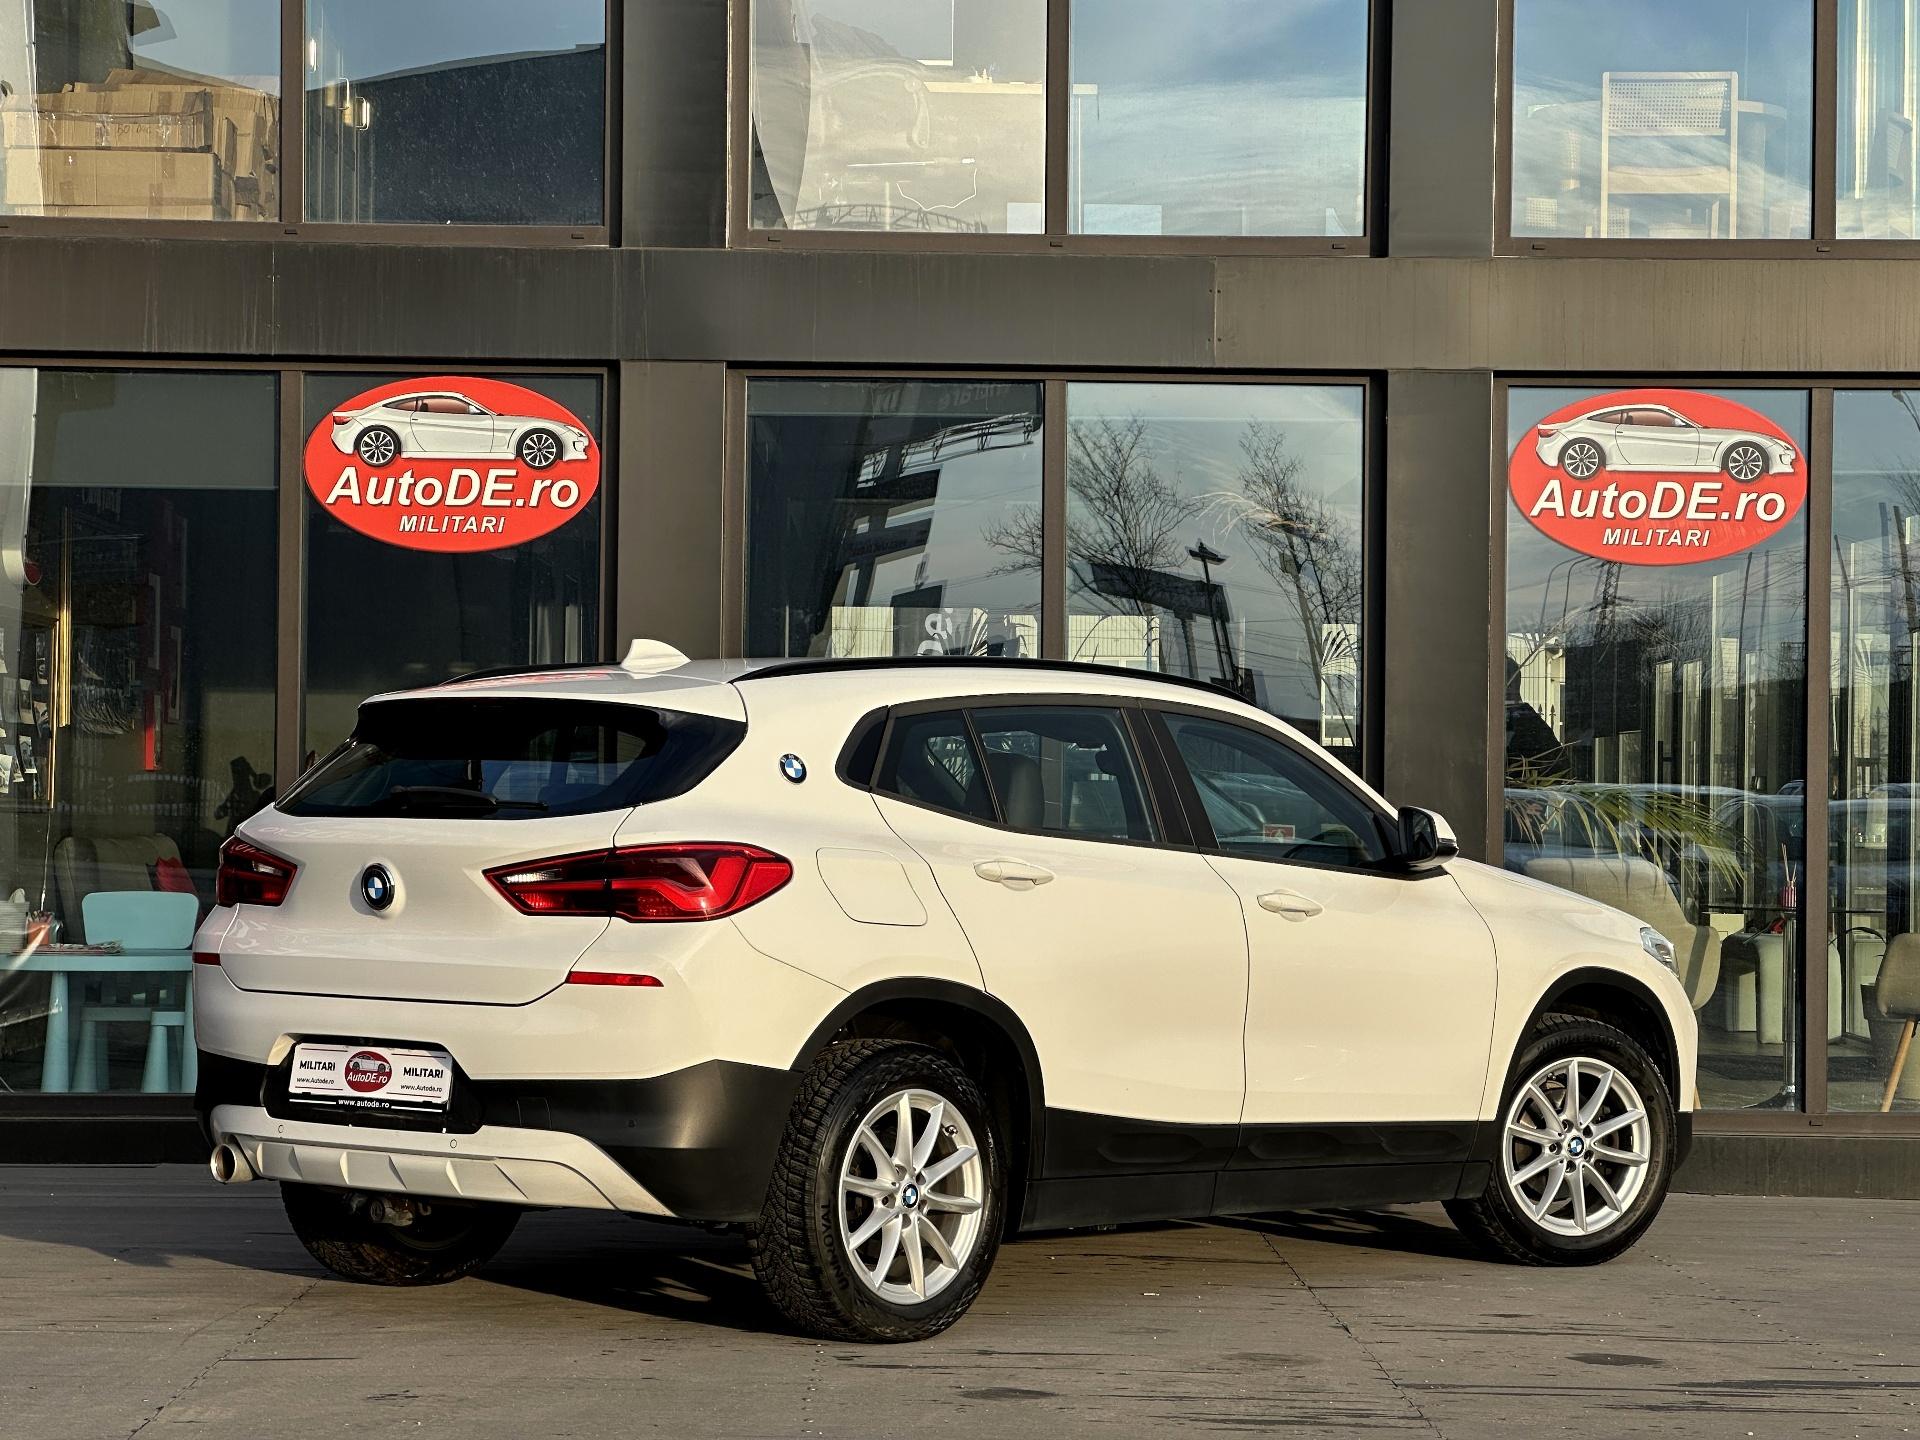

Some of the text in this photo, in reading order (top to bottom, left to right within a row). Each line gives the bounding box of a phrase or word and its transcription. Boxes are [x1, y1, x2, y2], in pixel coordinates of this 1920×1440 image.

[326, 466, 579, 508] AutoDE.ro
[1530, 479, 1786, 522] AutoDE.ro
[399, 515, 506, 533] MILITARI
[1603, 528, 1710, 547] MILITARI
[300, 1060, 336, 1071] MILITARI
[403, 1067, 444, 1079] MILITARI
[347, 1072, 388, 1084] AutoDE.ro
[338, 1099, 390, 1109] www.autode.ro
